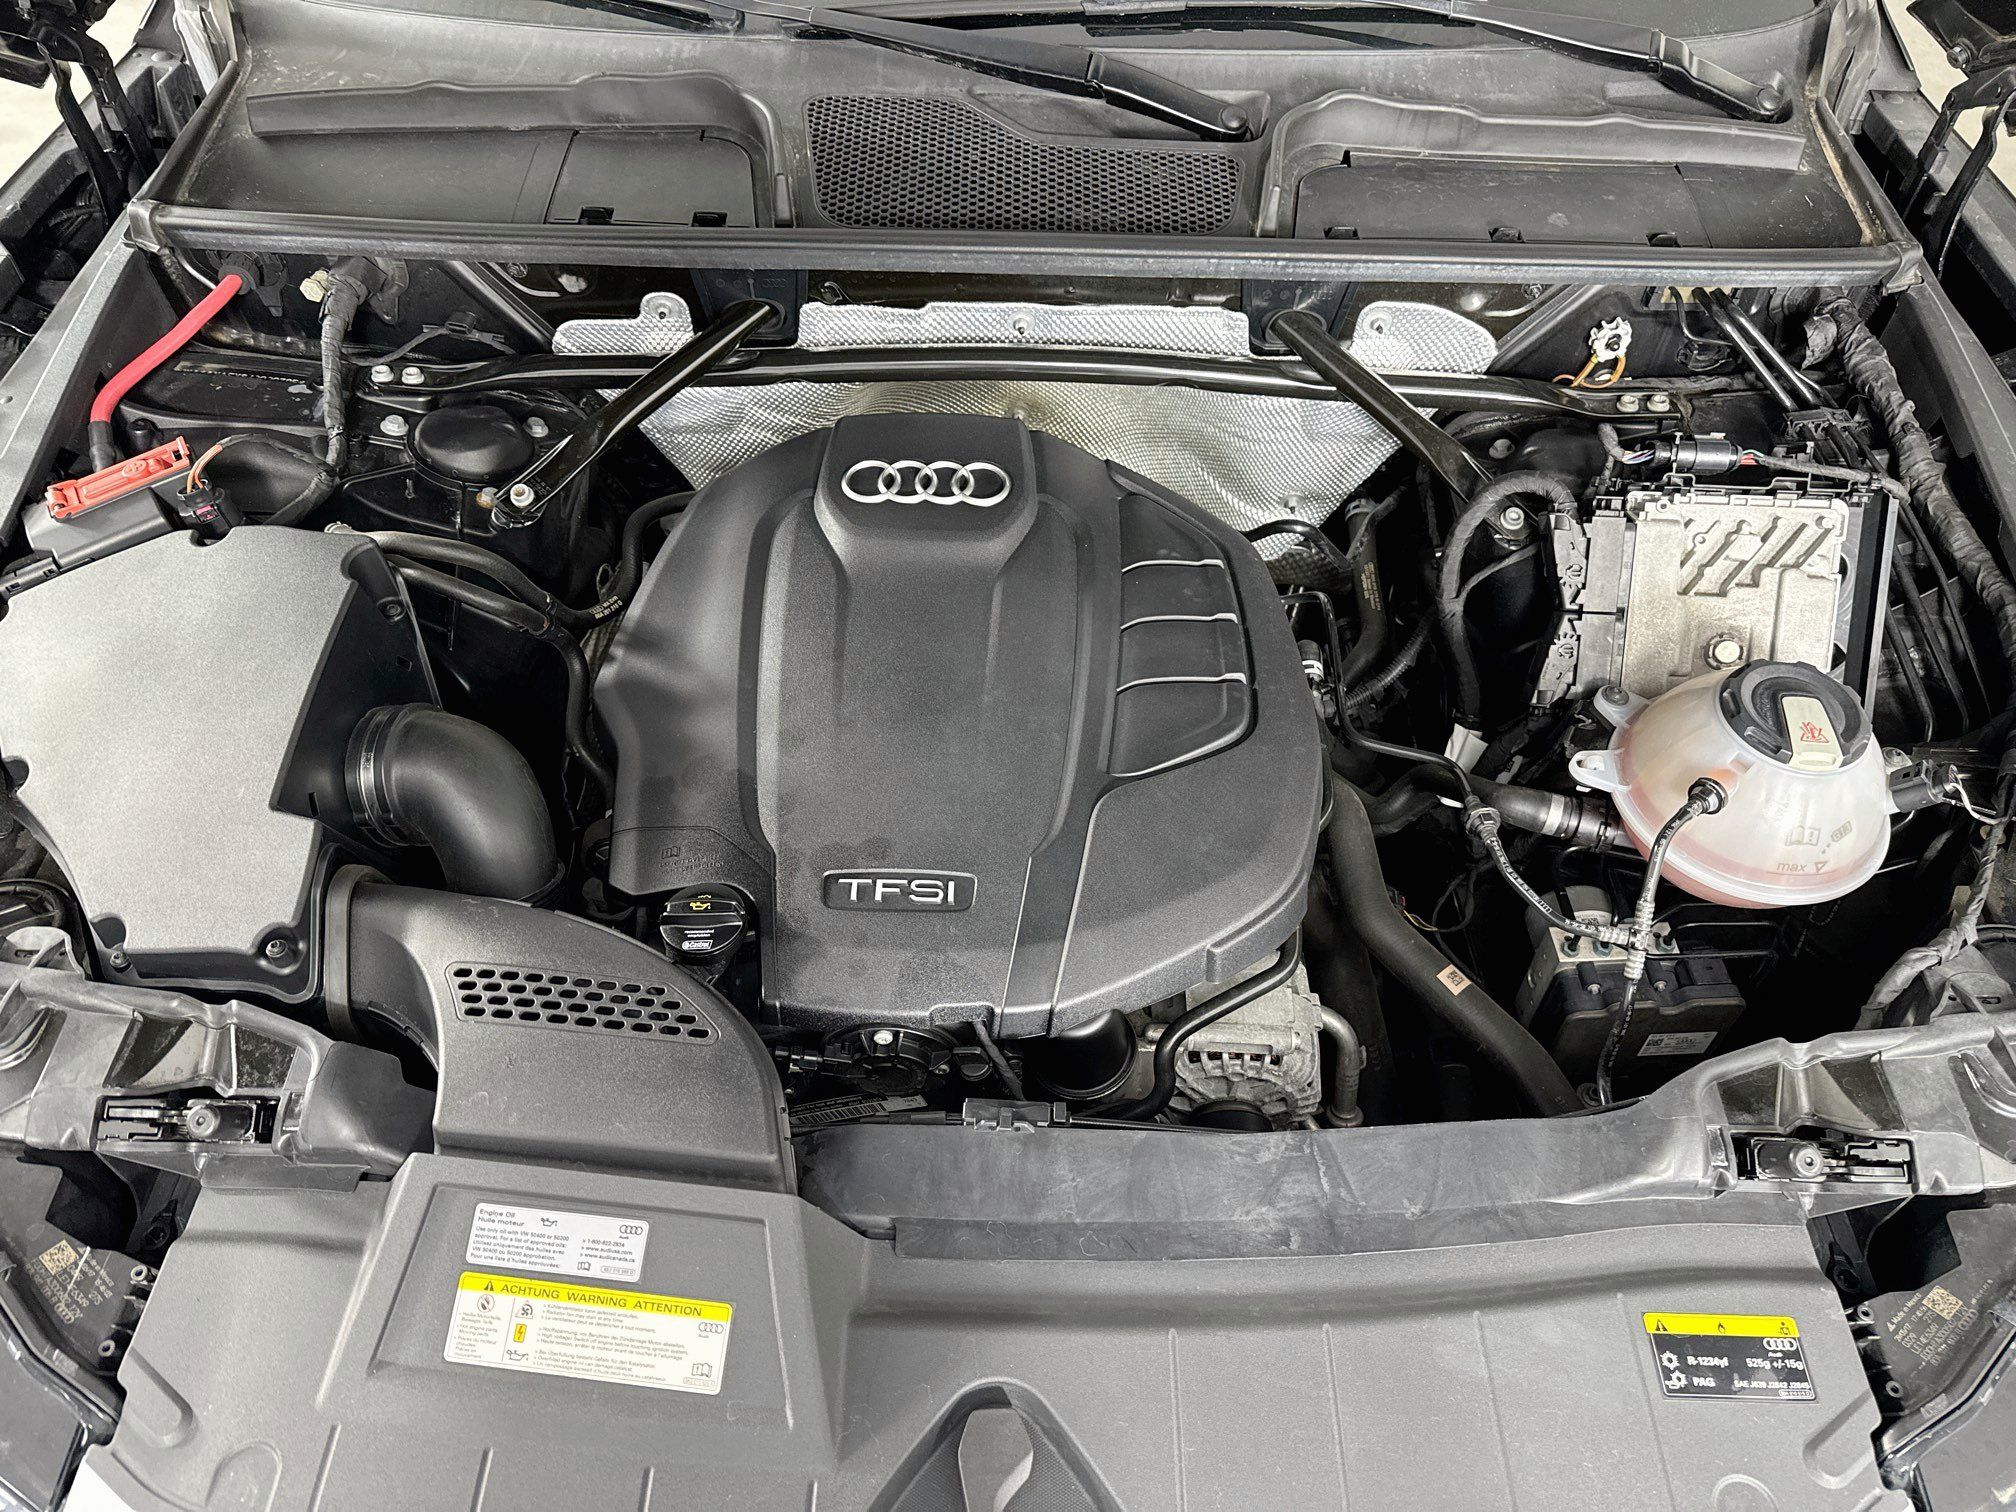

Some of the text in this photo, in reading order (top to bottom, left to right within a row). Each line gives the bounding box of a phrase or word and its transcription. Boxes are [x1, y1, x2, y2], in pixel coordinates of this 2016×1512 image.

[1776, 862, 1807, 872] max
[838, 878, 955, 906] TFSI
[480, 1209, 503, 1217] Engine
[586, 1247, 632, 1255] www.audiusa.com
[501, 1284, 701, 1316] ACHTUNG WARNING ATTENTION
[1686, 1356, 1730, 1368] R-1234yf
[1745, 1358, 1804, 1370] 525g +/-15g
[1692, 1377, 1716, 1387] PAG
[1733, 1380, 1750, 1388] SAE
